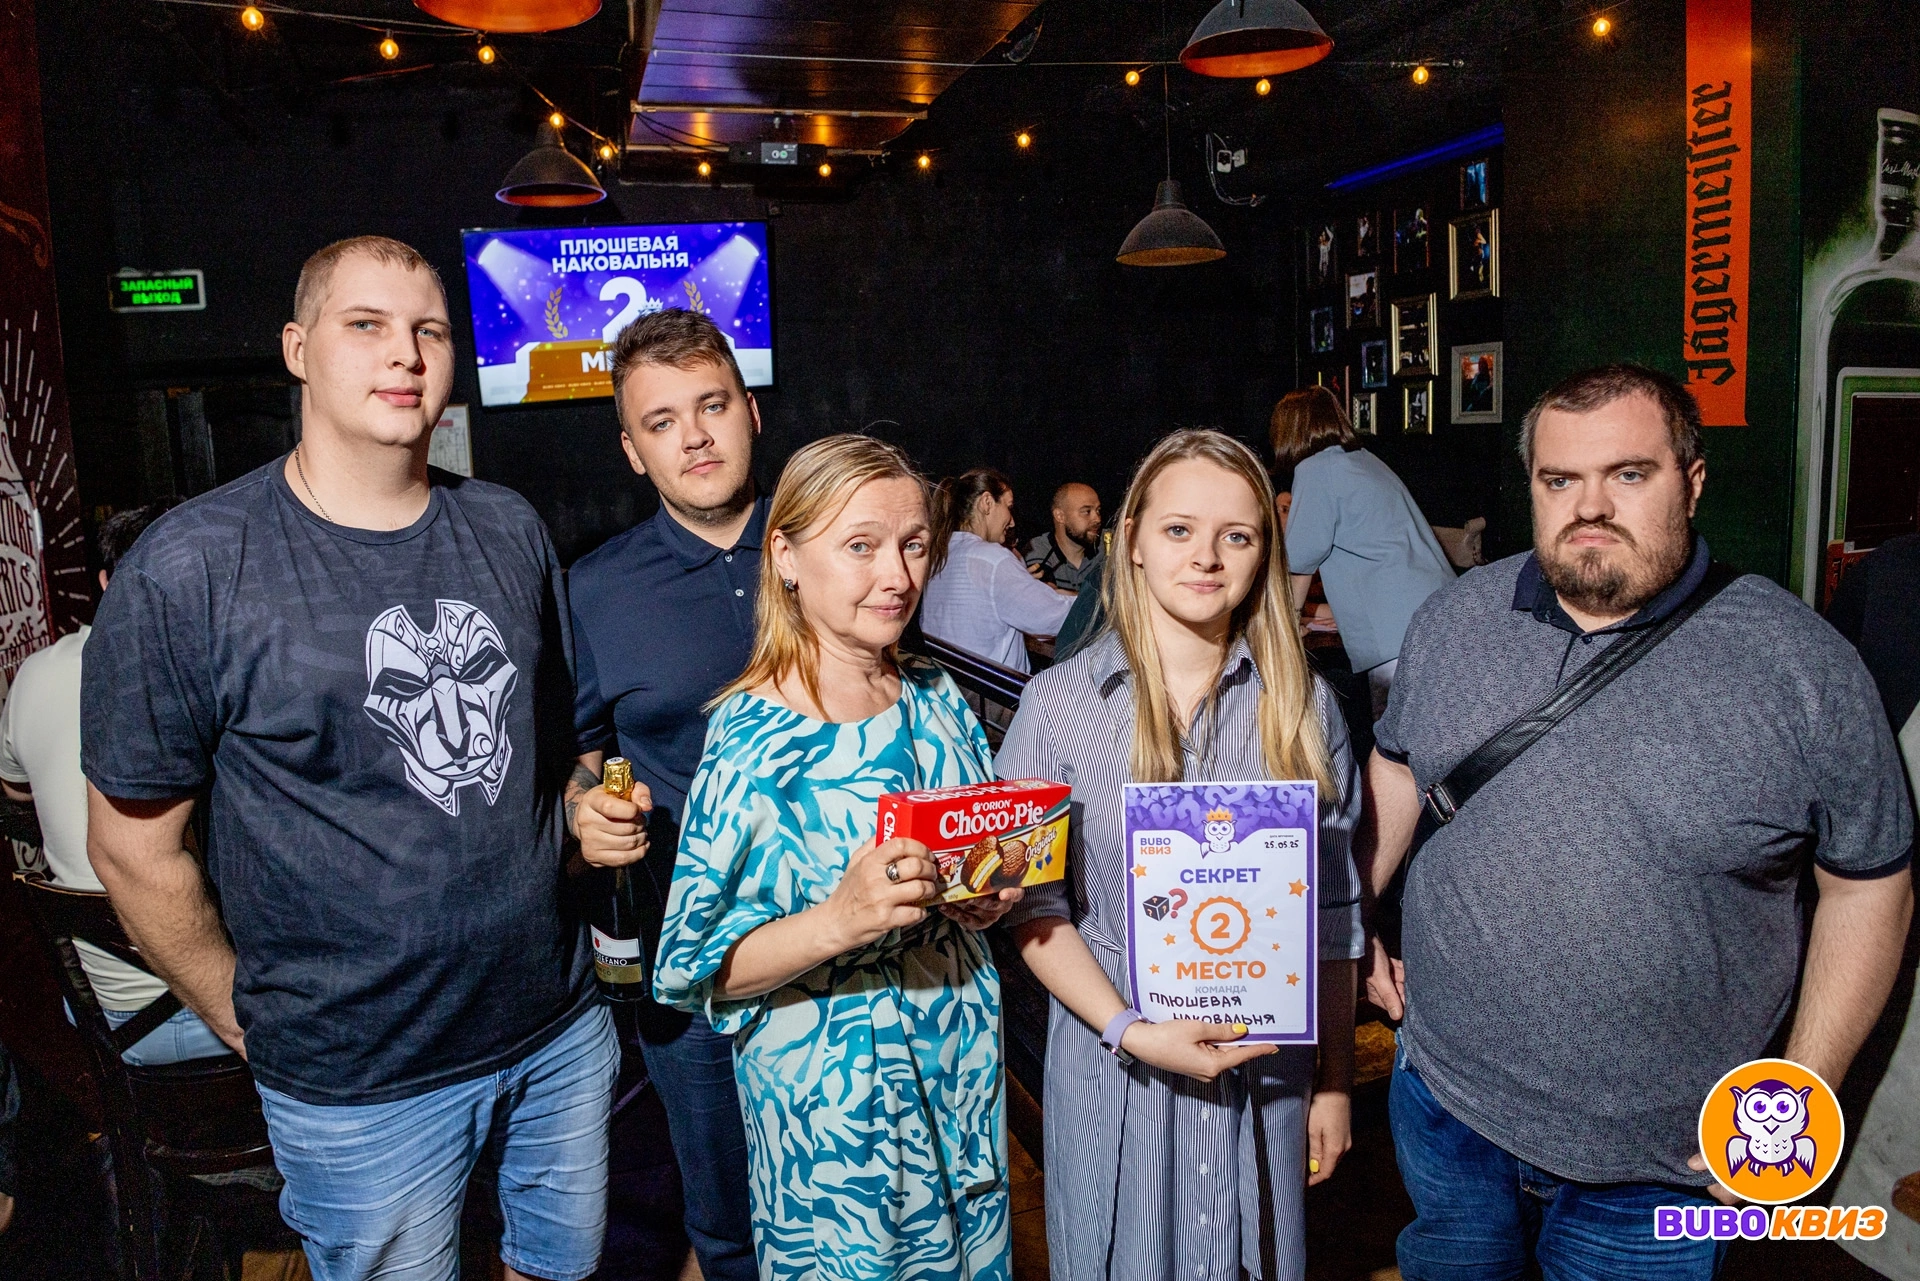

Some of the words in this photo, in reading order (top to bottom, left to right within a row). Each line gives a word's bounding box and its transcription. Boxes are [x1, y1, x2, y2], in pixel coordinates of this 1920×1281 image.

[560, 235, 679, 256] ПЛЮШЕВАЯ
[552, 252, 689, 273] НАКОВАЛЬНЯ
[120, 277, 194, 291] ЗАПАСНЫЙ
[132, 291, 182, 304] ВЫХОД
[599, 276, 647, 343] 2
[981, 799, 1011, 812] ORION
[1024, 826, 1057, 862] Original
[1140, 837, 1171, 846] BUBO
[1264, 840, 1299, 849] 25.05.25
[1140, 846, 1172, 855] КВИЗ
[1179, 868, 1261, 884] СЕКРЕТ
[1210, 912, 1230, 939] 2
[1176, 960, 1266, 980] МЕСТО
[1195, 985, 1248, 994] КОМАНДА
[1149, 992, 1242, 1008] ПЛЮШЕВАЯ
